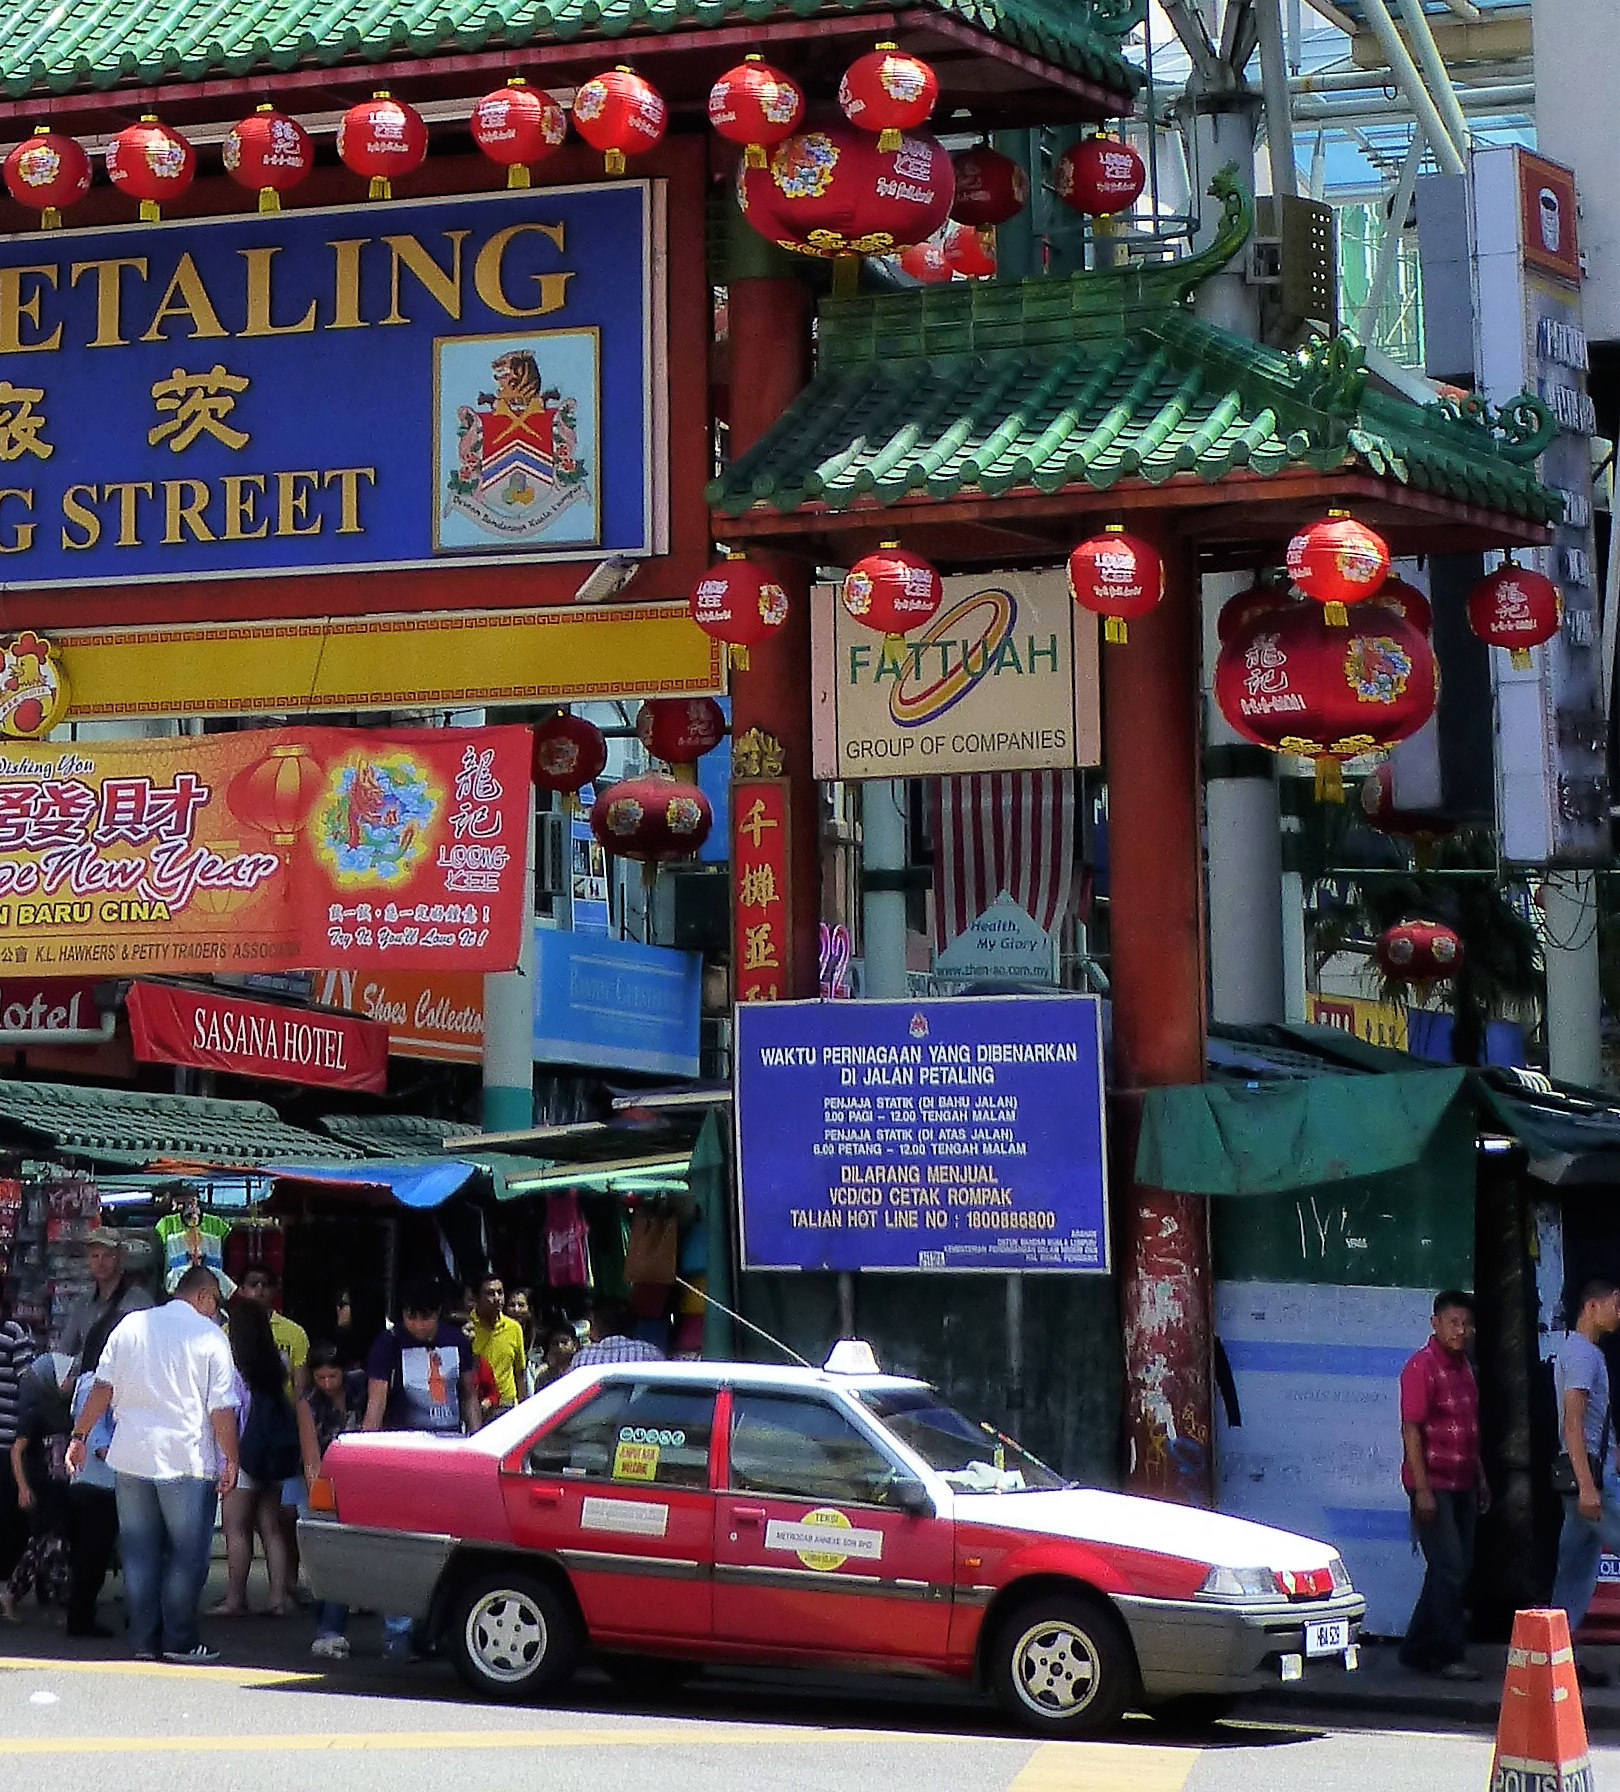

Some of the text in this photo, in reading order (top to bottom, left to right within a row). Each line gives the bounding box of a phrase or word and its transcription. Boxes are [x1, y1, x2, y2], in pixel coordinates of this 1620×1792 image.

[61, 467, 376, 551] STREET
[849, 634, 1059, 685] FATTUAH
[846, 730, 1066, 760] GROUP OF COMPANIES
[57, 754, 96, 776] You
[449, 745, 503, 839] 龍記
[437, 845, 510, 870] LOONG
[44, 840, 146, 895] New
[140, 838, 279, 911] Year
[444, 870, 501, 892] KEE
[18, 901, 92, 925] BARU
[100, 901, 171, 922] CINA
[328, 927, 352, 948] Try
[420, 928, 456, 946] Love
[976, 937, 996, 952] My
[1000, 937, 1038, 952] Glory
[121, 944, 129, 960] &
[131, 943, 170, 960] PETTY
[362, 982, 407, 1025] Shoes
[193, 1007, 348, 1072] SASANA HOTEL
[761, 1042, 1078, 1066] WAKTU PERNIAGAAN YANG DIBENARKAN
[840, 1066, 995, 1086] DI JALAN PETALING
[823, 1096, 872, 1110] PENJAJA
[876, 1096, 914, 1110] STATIK
[918, 1096, 934, 1111] (DI
[974, 1095, 1018, 1110] JALAN)
[848, 1110, 873, 1123] PAGI
[921, 1110, 968, 1123] TENGAH
[972, 1110, 1016, 1123] MALAM
[823, 1128, 1014, 1143] PENJAJA STATIK (DI ATAS JALAN)
[837, 1143, 882, 1157] PETANG
[931, 1143, 978, 1156] TENGAH
[982, 1143, 1027, 1156] MALAM
[840, 1165, 998, 1184] DILARANG MENJUAL
[829, 1187, 1012, 1206] VCD/CD CETAK ROMPAK
[790, 1209, 842, 1228] TALIAN
[847, 1210, 878, 1228] HOT
[884, 1210, 918, 1228] LINE
[925, 1210, 948, 1228] NO
[814, 1512, 839, 1524] TEKSI
